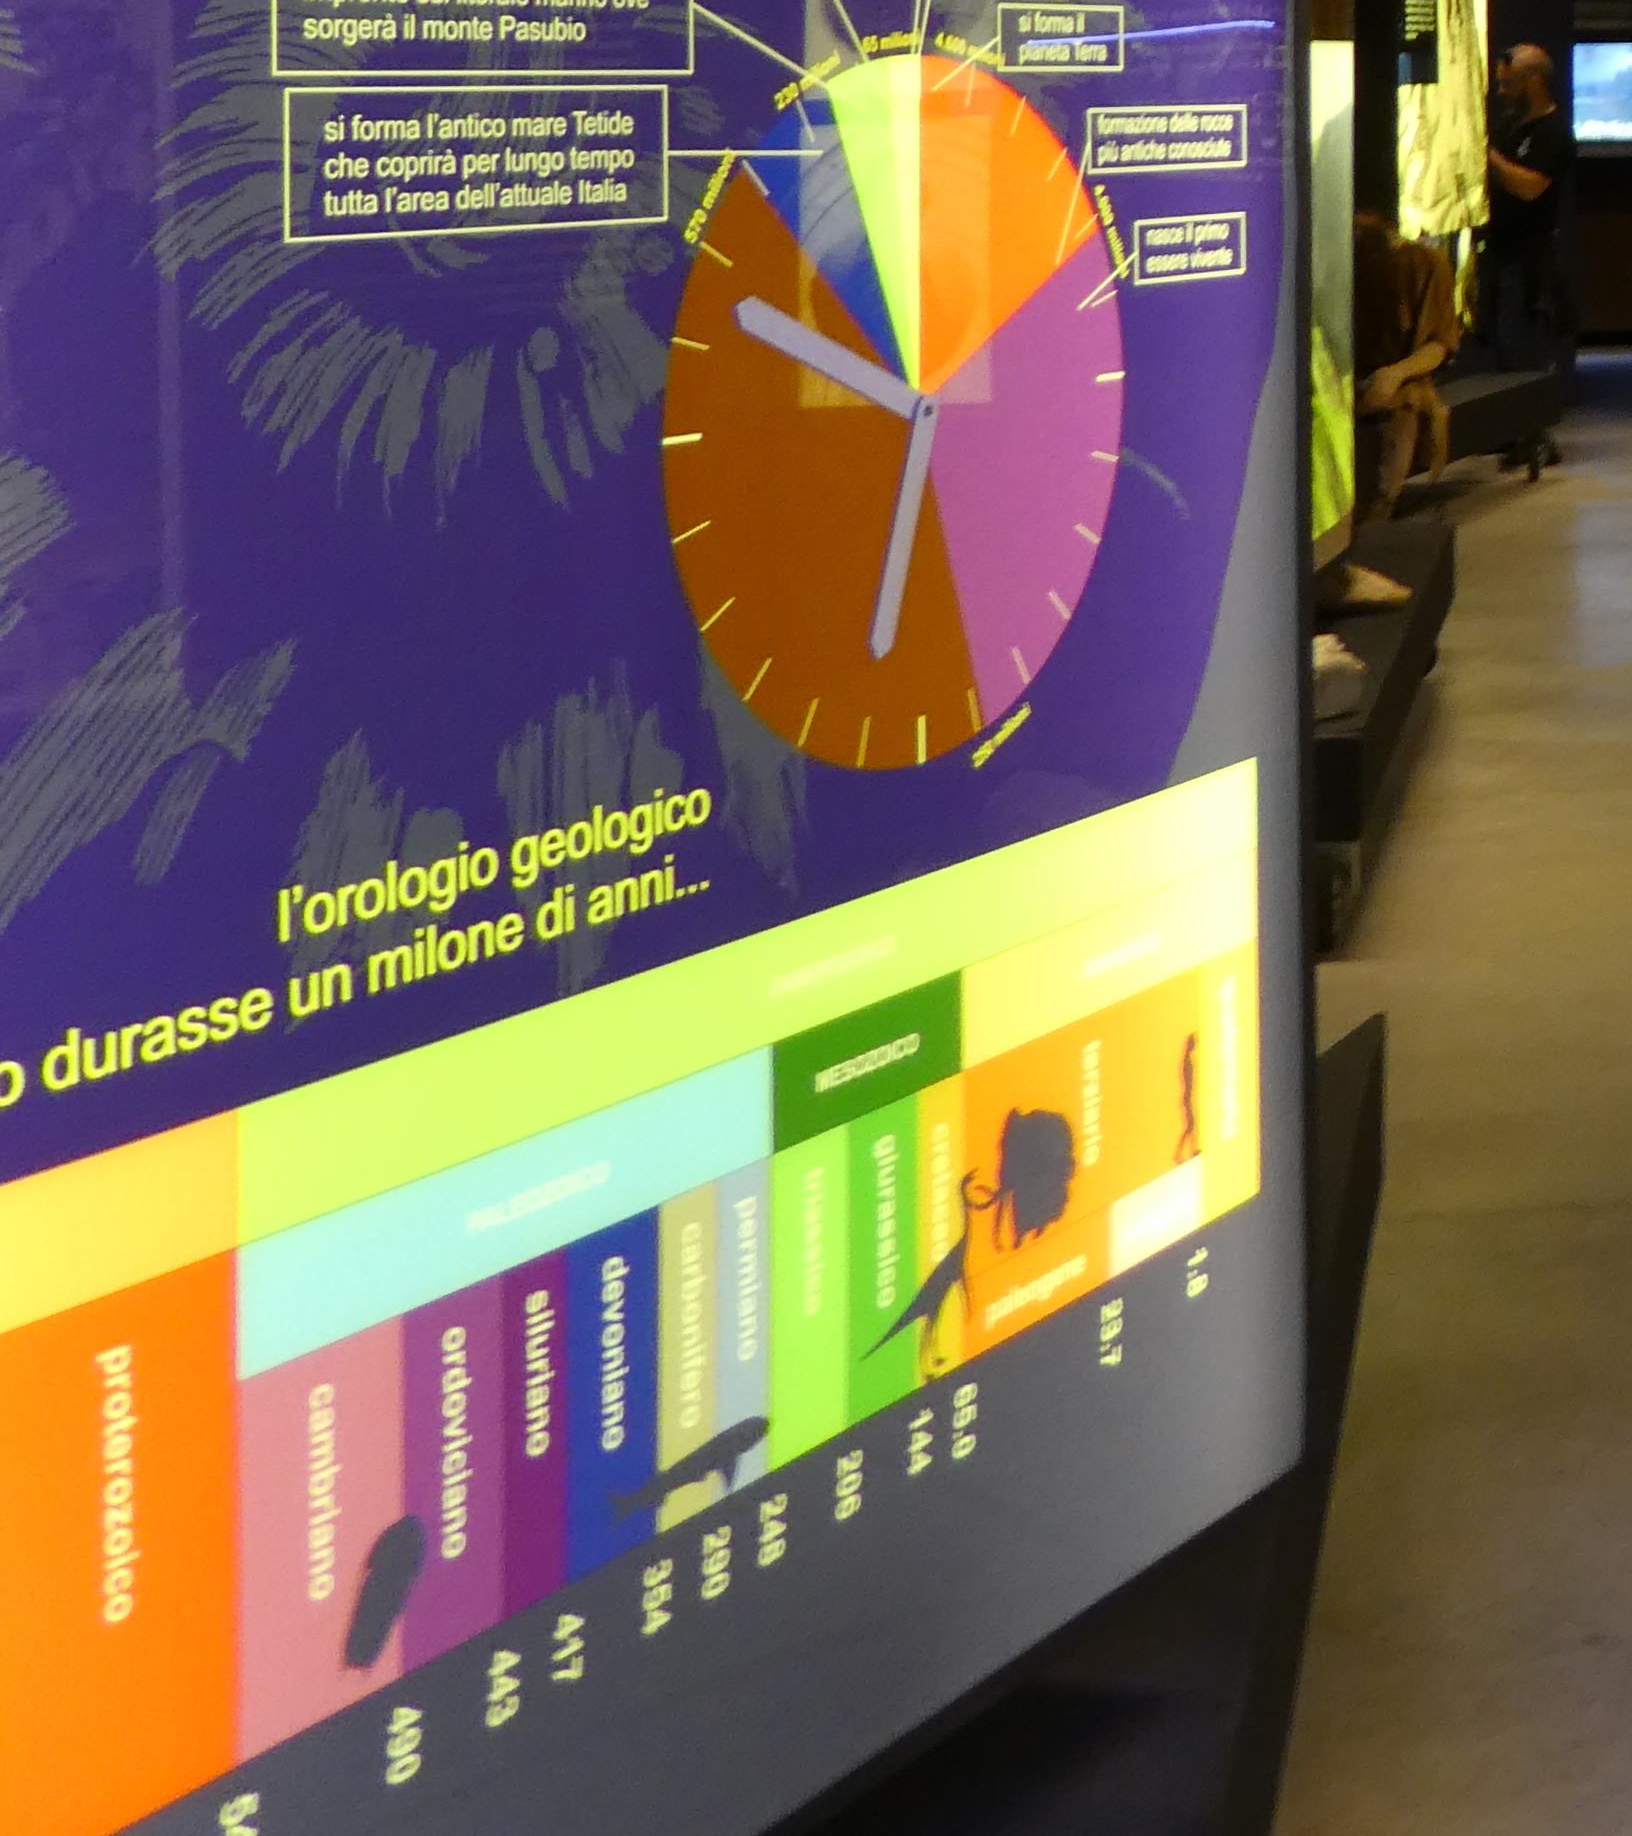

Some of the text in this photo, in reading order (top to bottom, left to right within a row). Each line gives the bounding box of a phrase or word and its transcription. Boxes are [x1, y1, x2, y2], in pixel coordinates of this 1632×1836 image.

[303, 14, 587, 48] sorgerà il monte Pasubio
[1034, 12, 1075, 34] forma
[1075, 42, 1108, 62] Terra
[324, 114, 345, 142] si
[352, 113, 421, 141] forma
[512, 113, 567, 137] mare
[573, 109, 634, 136] Tetide
[324, 144, 635, 184] che coprirà per lungo tempo
[324, 190, 378, 219] tutta
[579, 177, 628, 205] Italia
[511, 787, 712, 890] geologico
[42, 987, 274, 1091] durasse
[290, 961, 352, 1017] un
[367, 911, 525, 995] milone
[538, 883, 574, 941] di
[587, 854, 711, 925] anni...
[872, 1133, 900, 1310] giurassico
[733, 1195, 761, 1362] permiano
[600, 1255, 630, 1452] devoniano
[680, 1222, 706, 1430] carbonifero
[524, 1289, 556, 1458] siluriano
[440, 1326, 473, 1560] ordoviciano
[906, 1407, 934, 1476] 144
[950, 1382, 979, 1461] 65.0
[95, 1343, 139, 1624] proterozoico
[307, 1382, 342, 1602] cambriano
[835, 1449, 864, 1521] 206
[699, 1525, 733, 1599] 290
[757, 1493, 788, 1567] 248
[640, 1557, 674, 1637] 354
[551, 1612, 585, 1682] 417
[385, 1705, 423, 1785] 490
